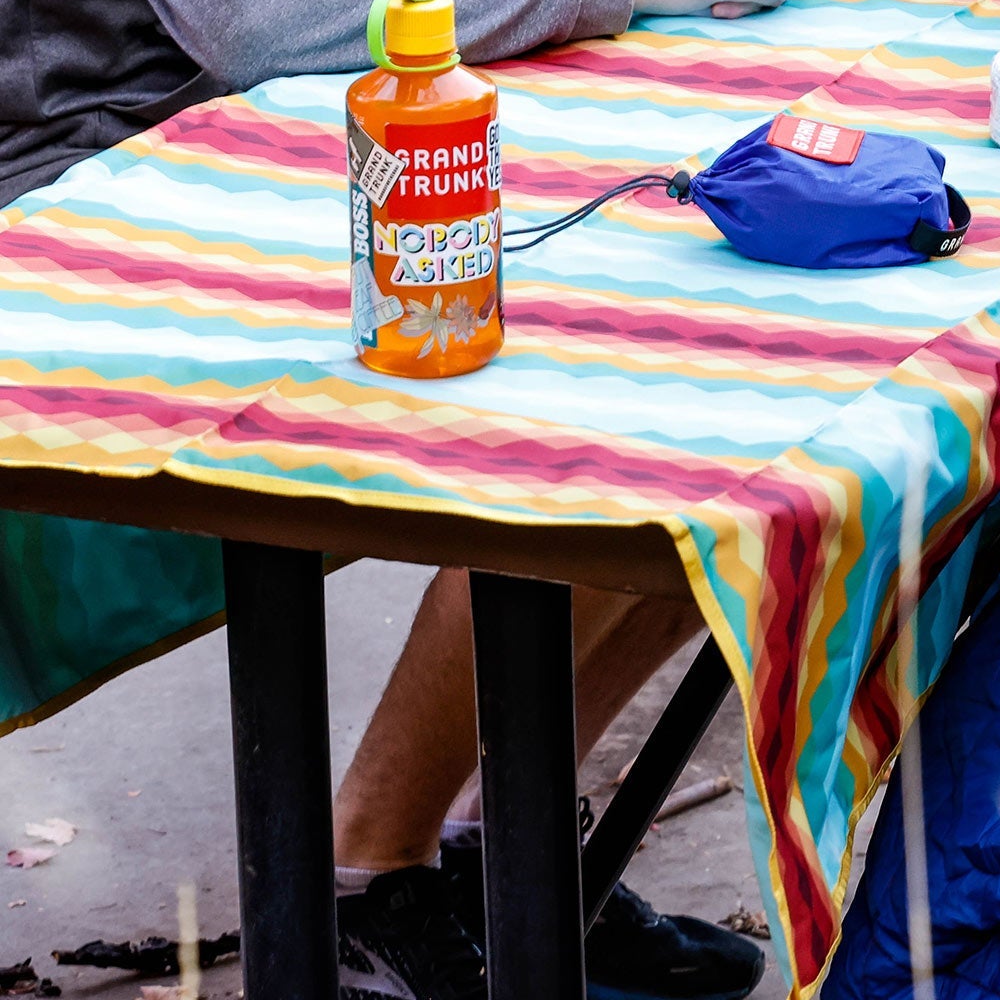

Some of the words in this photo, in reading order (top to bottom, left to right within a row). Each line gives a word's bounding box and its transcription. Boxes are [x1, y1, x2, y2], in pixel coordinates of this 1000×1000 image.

[363, 151, 383, 187] GRAND
[394, 141, 484, 171] GRAND
[369, 155, 393, 194] TRUNK
[398, 167, 486, 197] TRUNK
[352, 189, 370, 257] BOSS
[375, 211, 500, 254] NOBODY
[393, 248, 493, 283] ASKED
